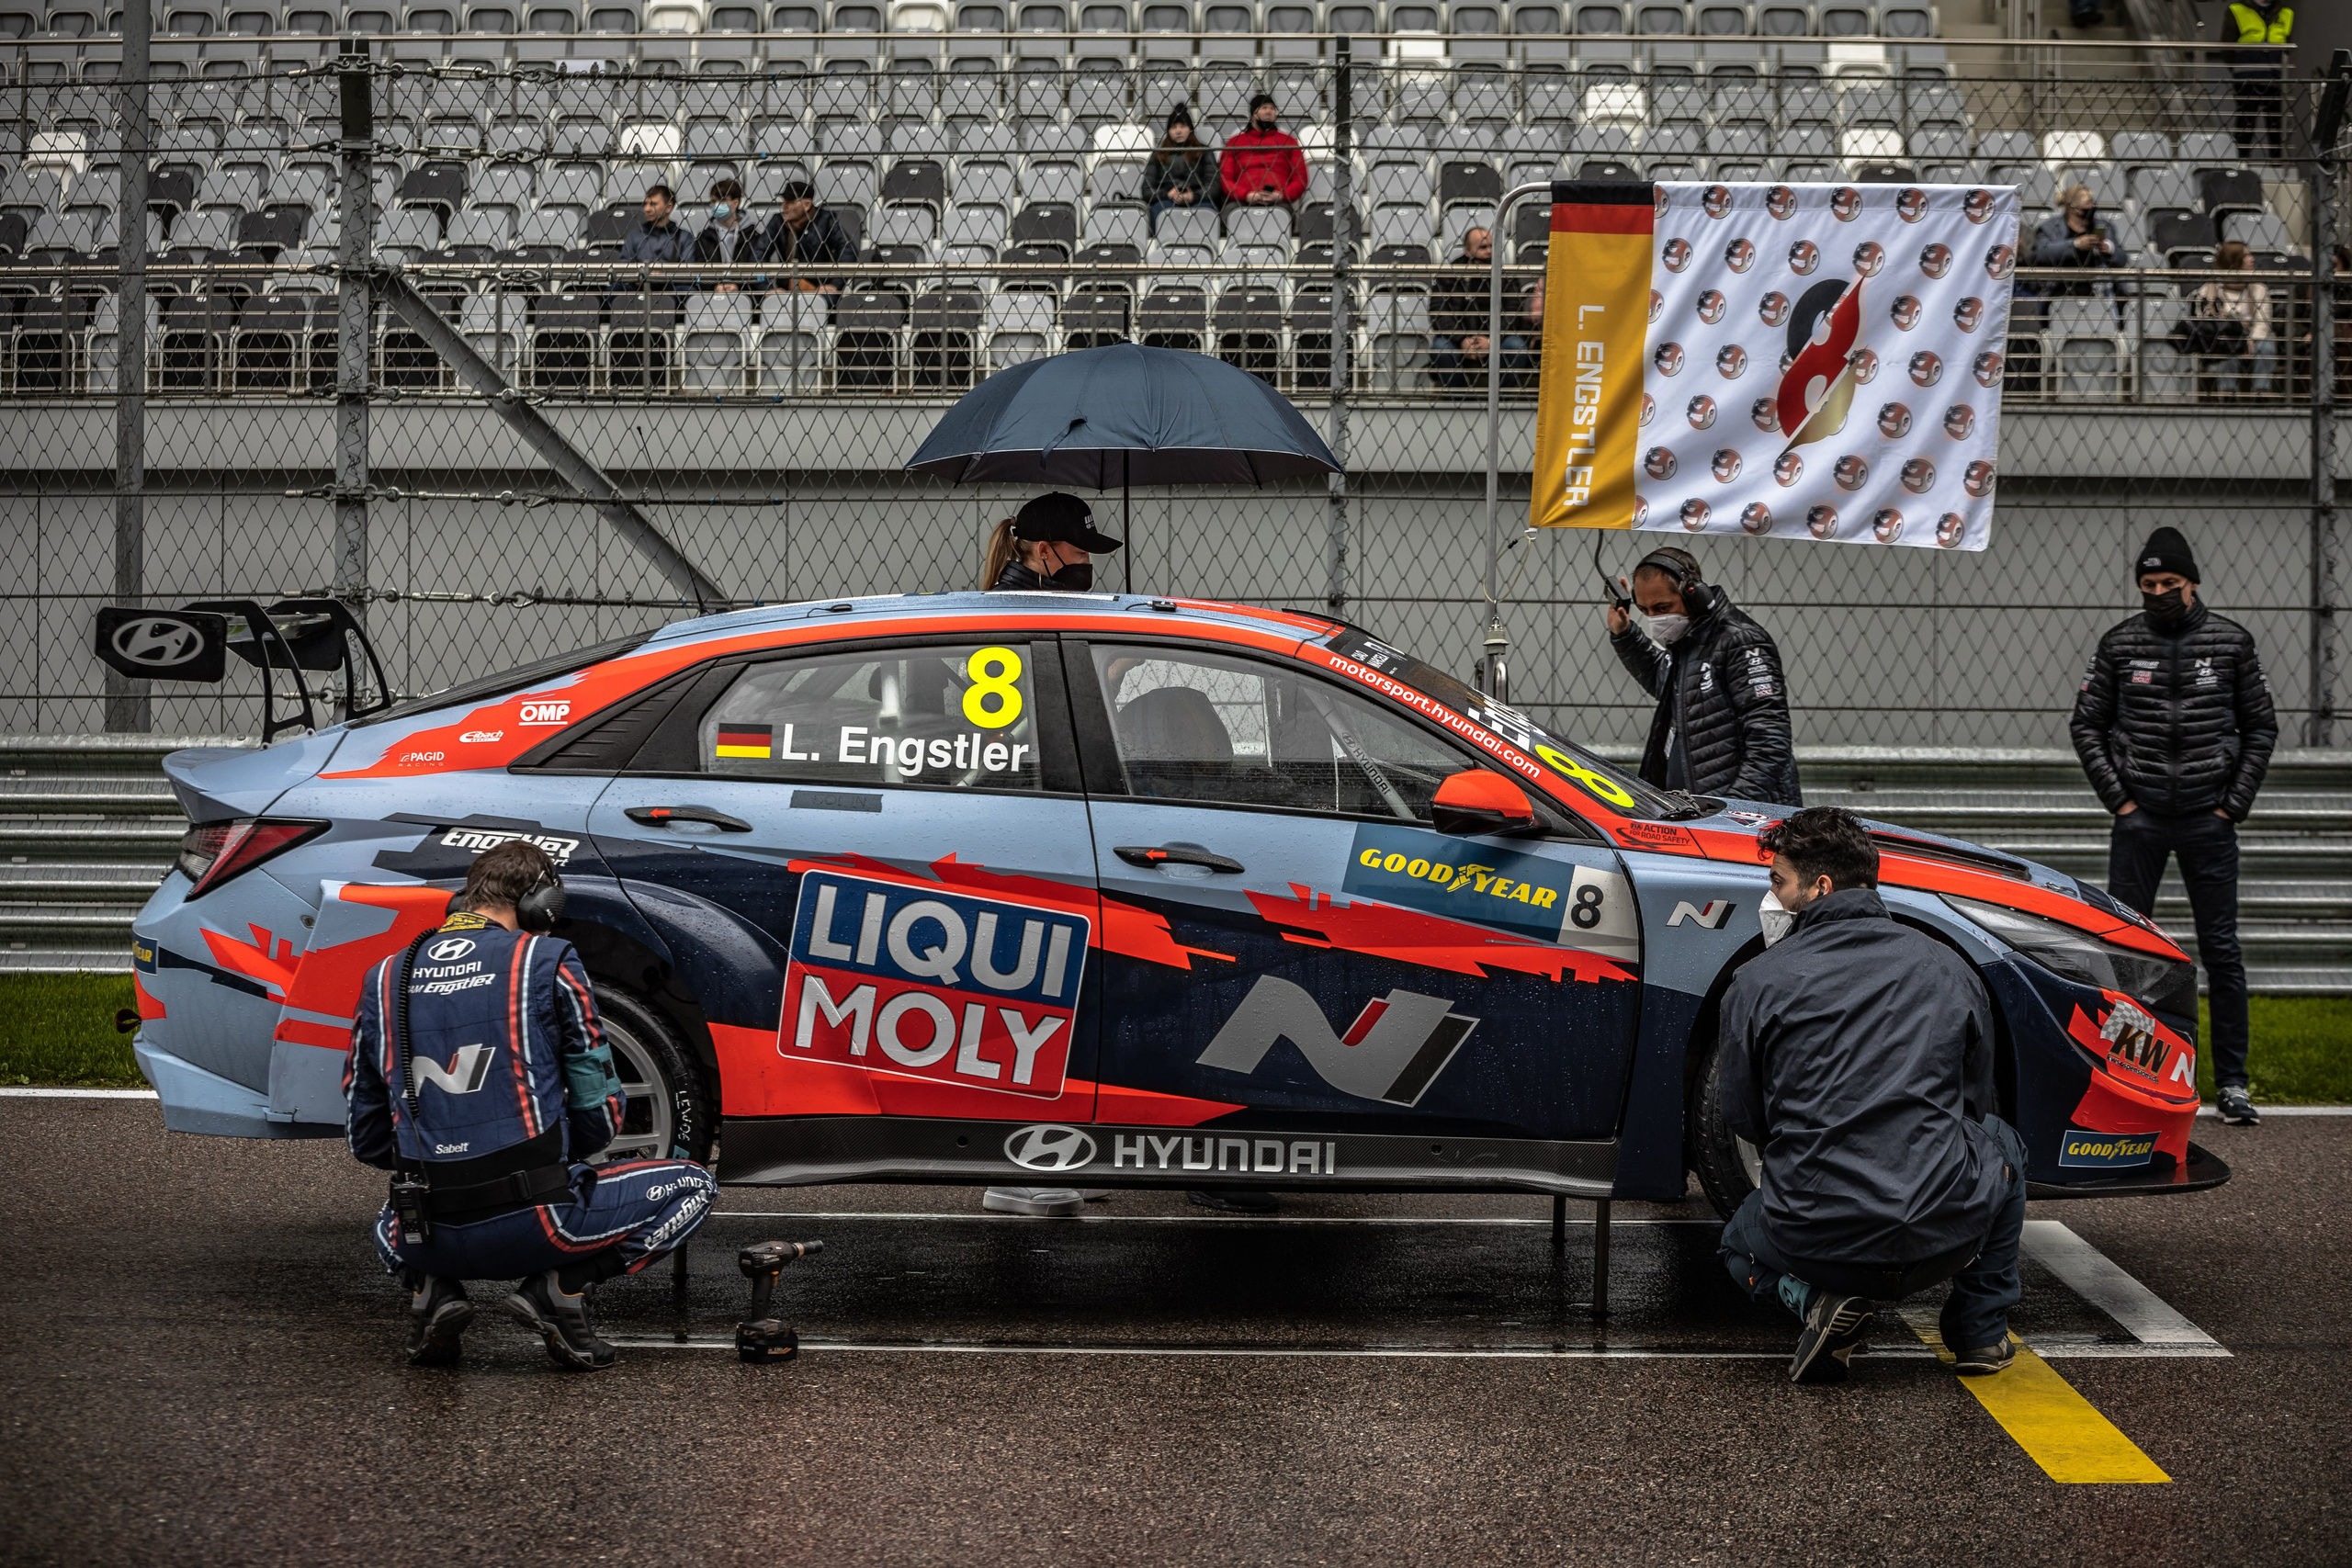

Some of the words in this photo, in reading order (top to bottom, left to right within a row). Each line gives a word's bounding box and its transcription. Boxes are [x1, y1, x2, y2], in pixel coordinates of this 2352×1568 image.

[1577, 304, 1606, 331] L.
[1563, 341, 1605, 507] ENGSTLER
[962, 647, 1023, 728] 8
[520, 704, 570, 722] OMP
[1329, 654, 1541, 780] motorsport.hyundai.com
[458, 730, 504, 743] Eibach
[782, 723, 820, 761] L.
[839, 727, 1029, 777] Engstler
[411, 751, 445, 761] PAGID
[1353, 747, 1391, 795] HYUNDAI
[1535, 744, 1634, 808] 8
[440, 828, 580, 858] Engtler
[1641, 831, 1662, 841] ROAD
[1662, 835, 1690, 845] SAFETY
[1644, 824, 1678, 836] ACTION
[1360, 849, 1557, 909] GOODYEAR
[1571, 884, 1603, 930] 8
[808, 883, 1073, 998] LIQUI
[413, 961, 482, 979] HYUNDAI
[424, 974, 496, 995] Engstler
[795, 974, 1068, 1086] MOLY
[2109, 1021, 2173, 1077] KW
[435, 1142, 469, 1155] Sabelt
[1114, 1134, 1335, 1175] HYUNDAI
[2068, 1140, 2152, 1158] GOODYEAR
